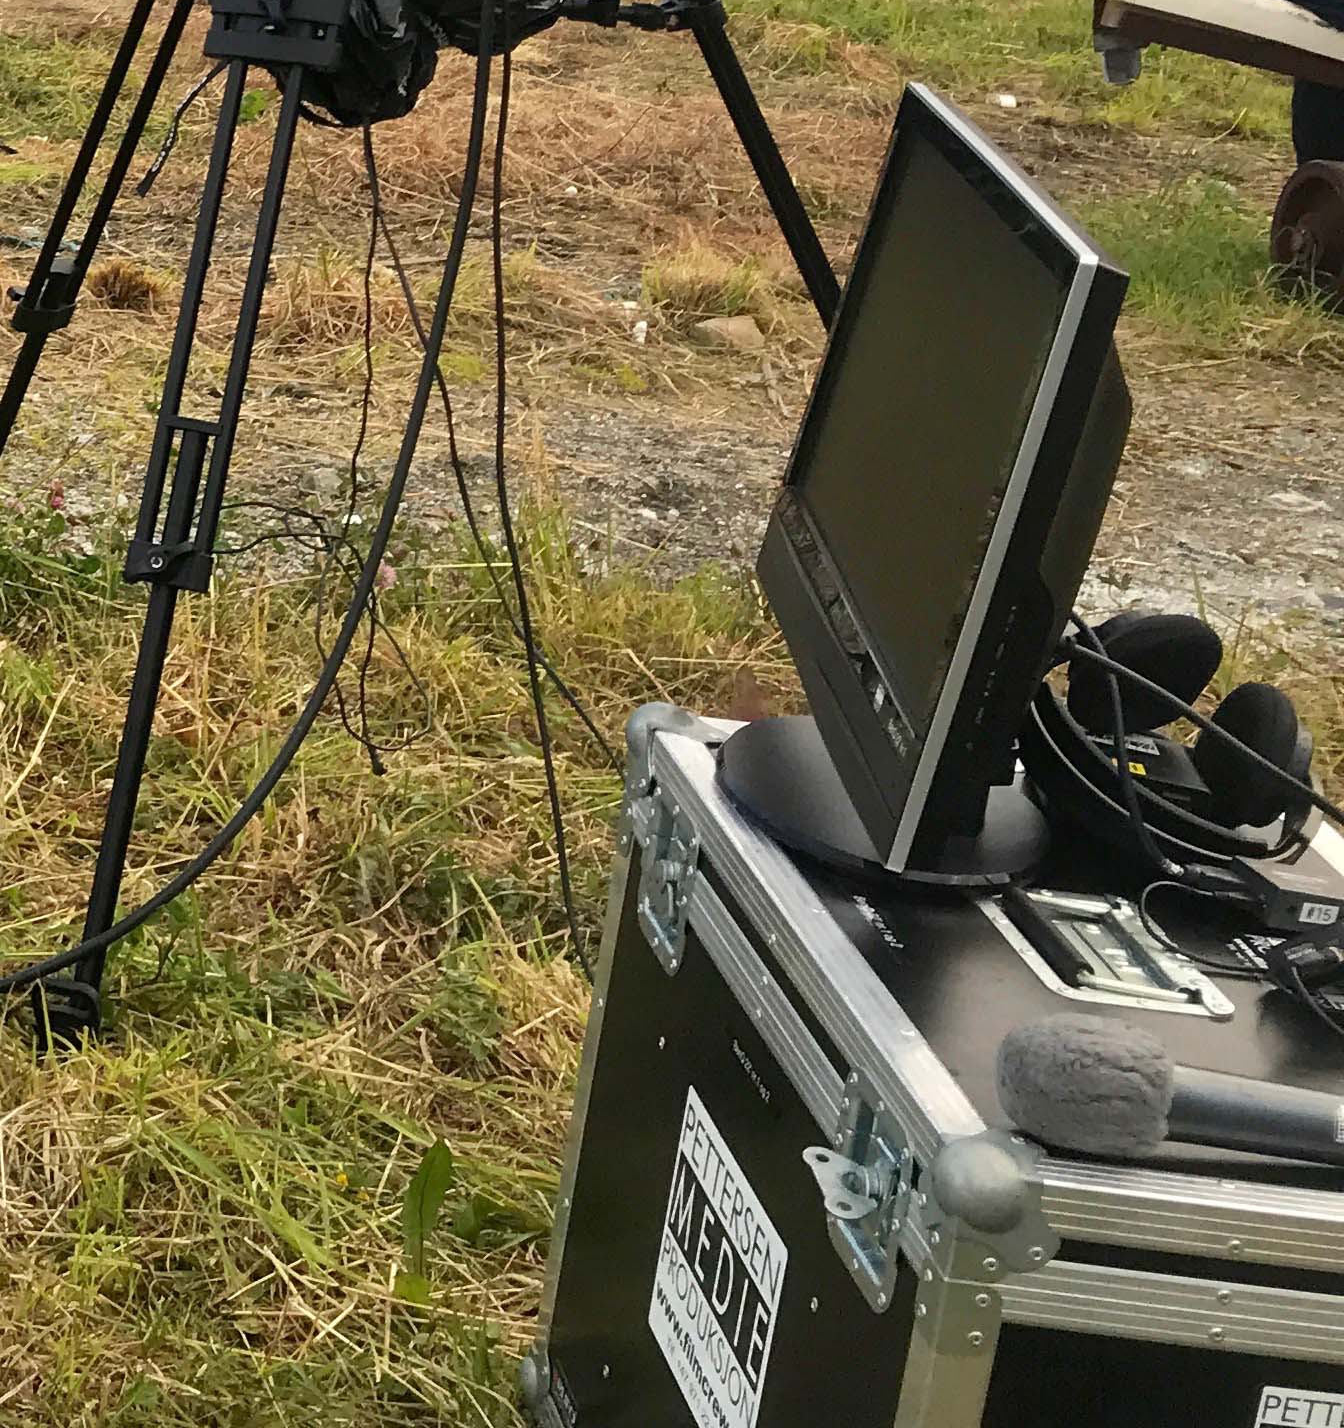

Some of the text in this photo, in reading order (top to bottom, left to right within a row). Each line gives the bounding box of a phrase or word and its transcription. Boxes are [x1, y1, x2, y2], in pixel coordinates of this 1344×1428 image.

[670, 1163, 770, 1384] MEDIE
[682, 1102, 782, 1305] PETTERSEN
[661, 1233, 754, 1428] PRODUKSJON
[1261, 1394, 1344, 1428] PETT
